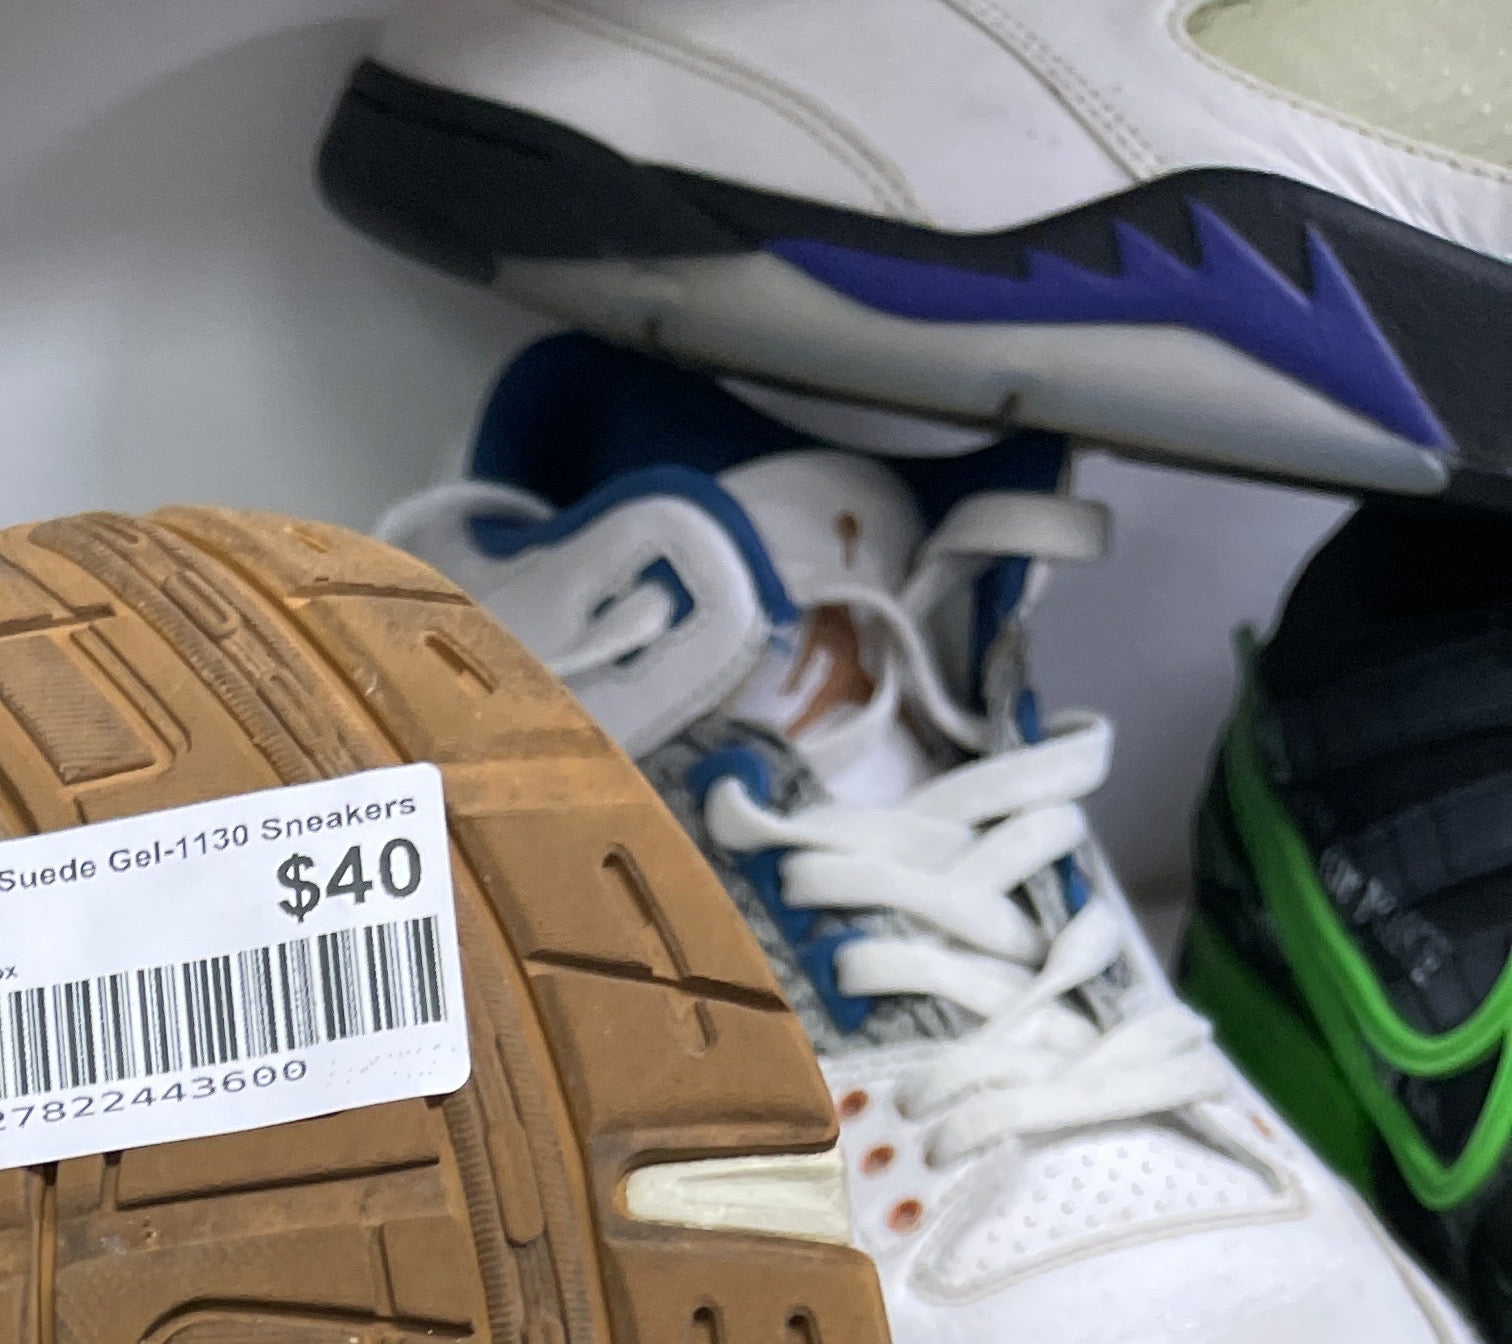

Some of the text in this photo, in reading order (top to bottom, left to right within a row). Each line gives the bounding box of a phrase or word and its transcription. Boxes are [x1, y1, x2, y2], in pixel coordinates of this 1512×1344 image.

[108, 824, 250, 873] Gel-1130
[261, 796, 417, 841] Sneakers
[276, 837, 423, 923] $40
